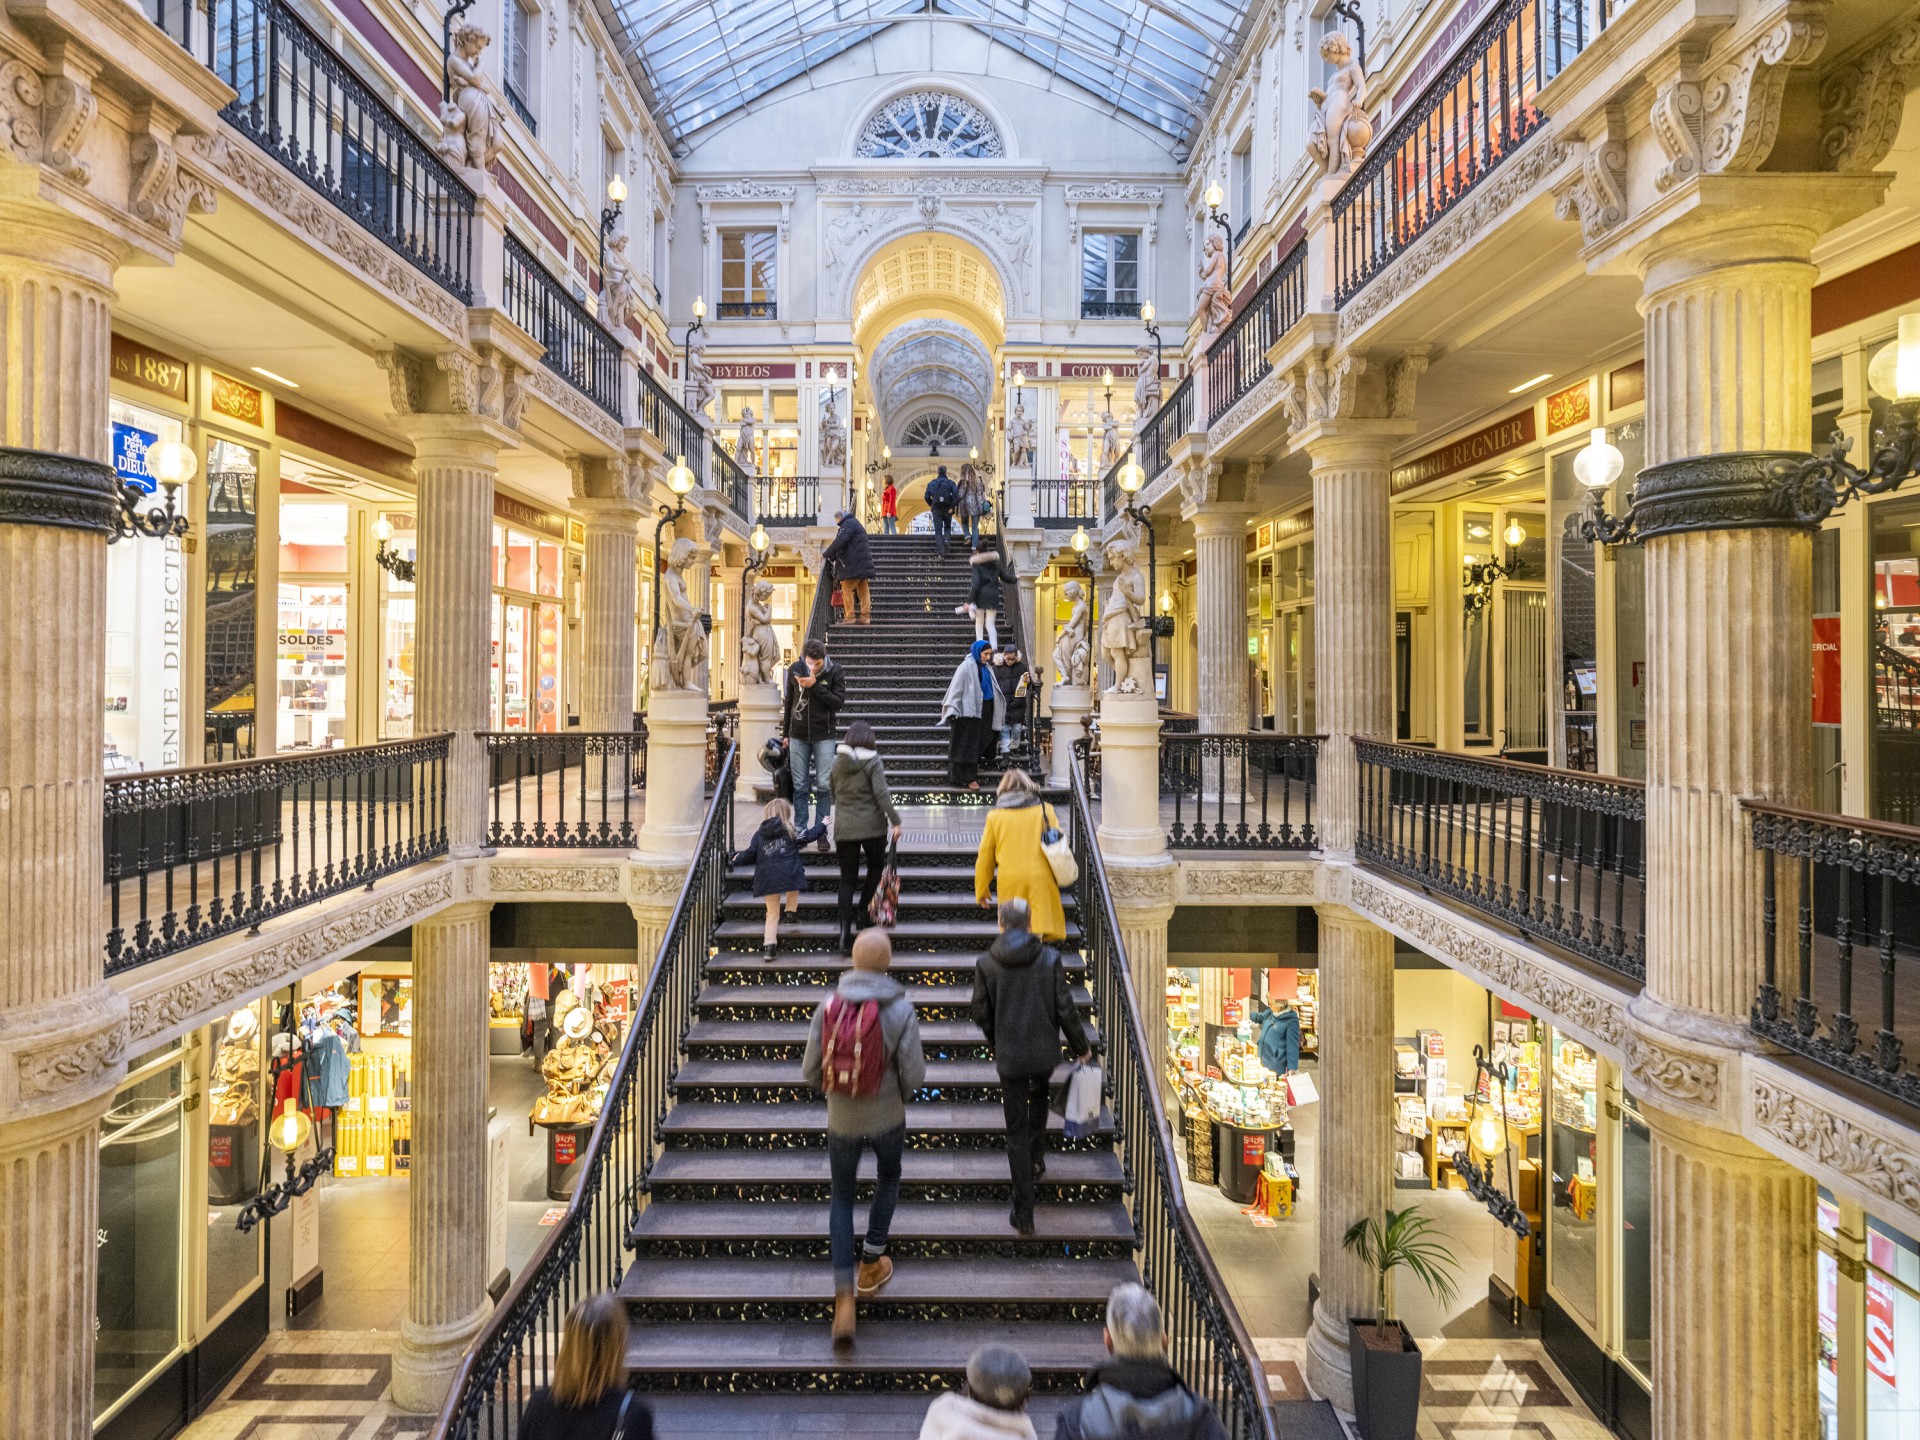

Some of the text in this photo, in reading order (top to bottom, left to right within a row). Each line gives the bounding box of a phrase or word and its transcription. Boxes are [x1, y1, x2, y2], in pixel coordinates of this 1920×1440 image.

[132, 352, 182, 392] 1887
[715, 365, 771, 378] BYBLOS
[1396, 420, 1524, 489] GALERIE REGNIER
[502, 499, 548, 529] LE CREUSET
[164, 537, 179, 671] DIRECTE
[278, 634, 334, 646] SOLDES
